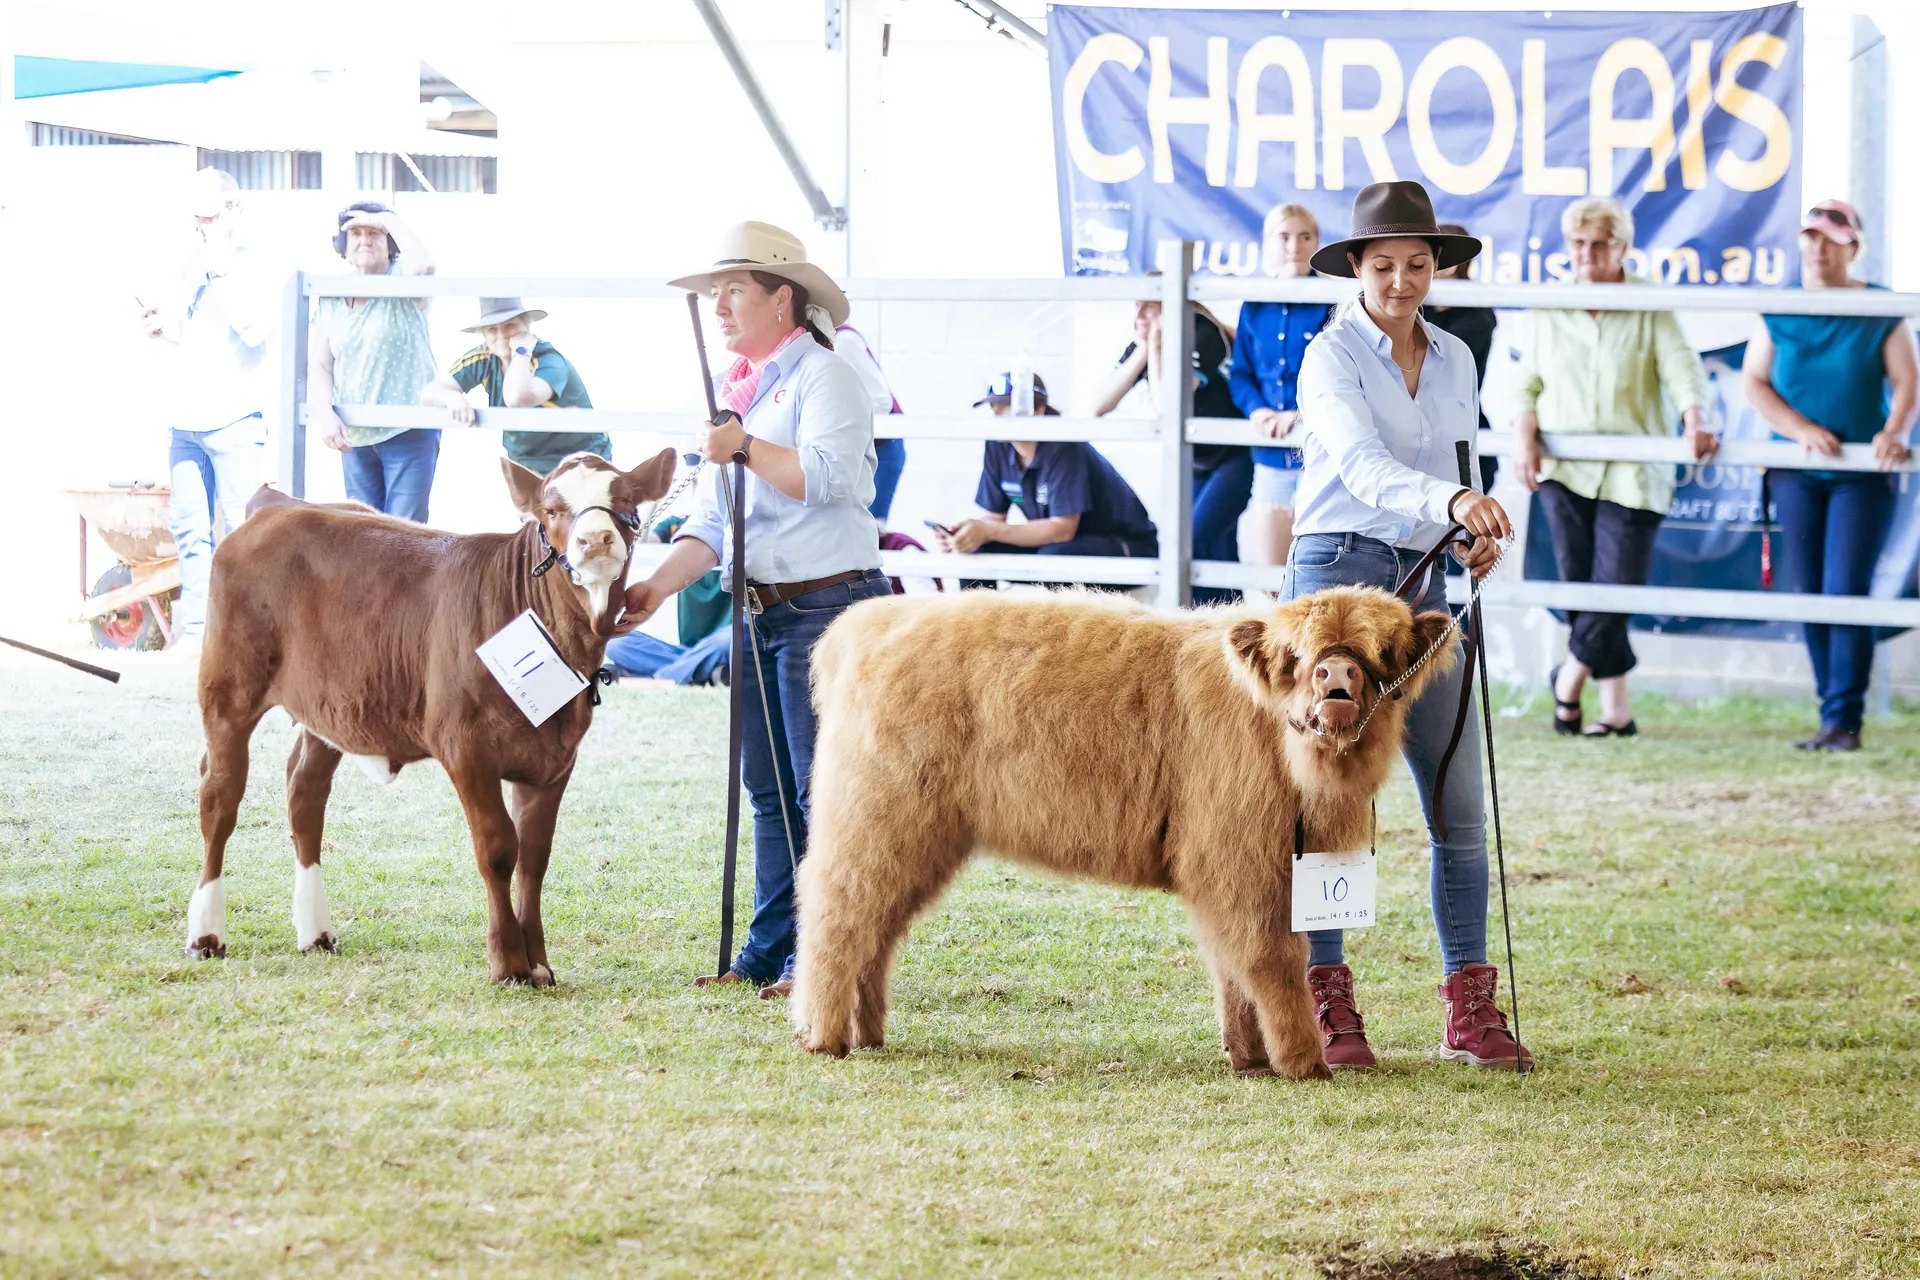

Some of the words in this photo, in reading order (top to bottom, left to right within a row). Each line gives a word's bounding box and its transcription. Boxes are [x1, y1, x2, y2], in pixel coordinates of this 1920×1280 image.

[1063, 32, 1793, 196] CHAROLAIS
[513, 650, 544, 678] 11
[1323, 876, 1349, 902] 10
